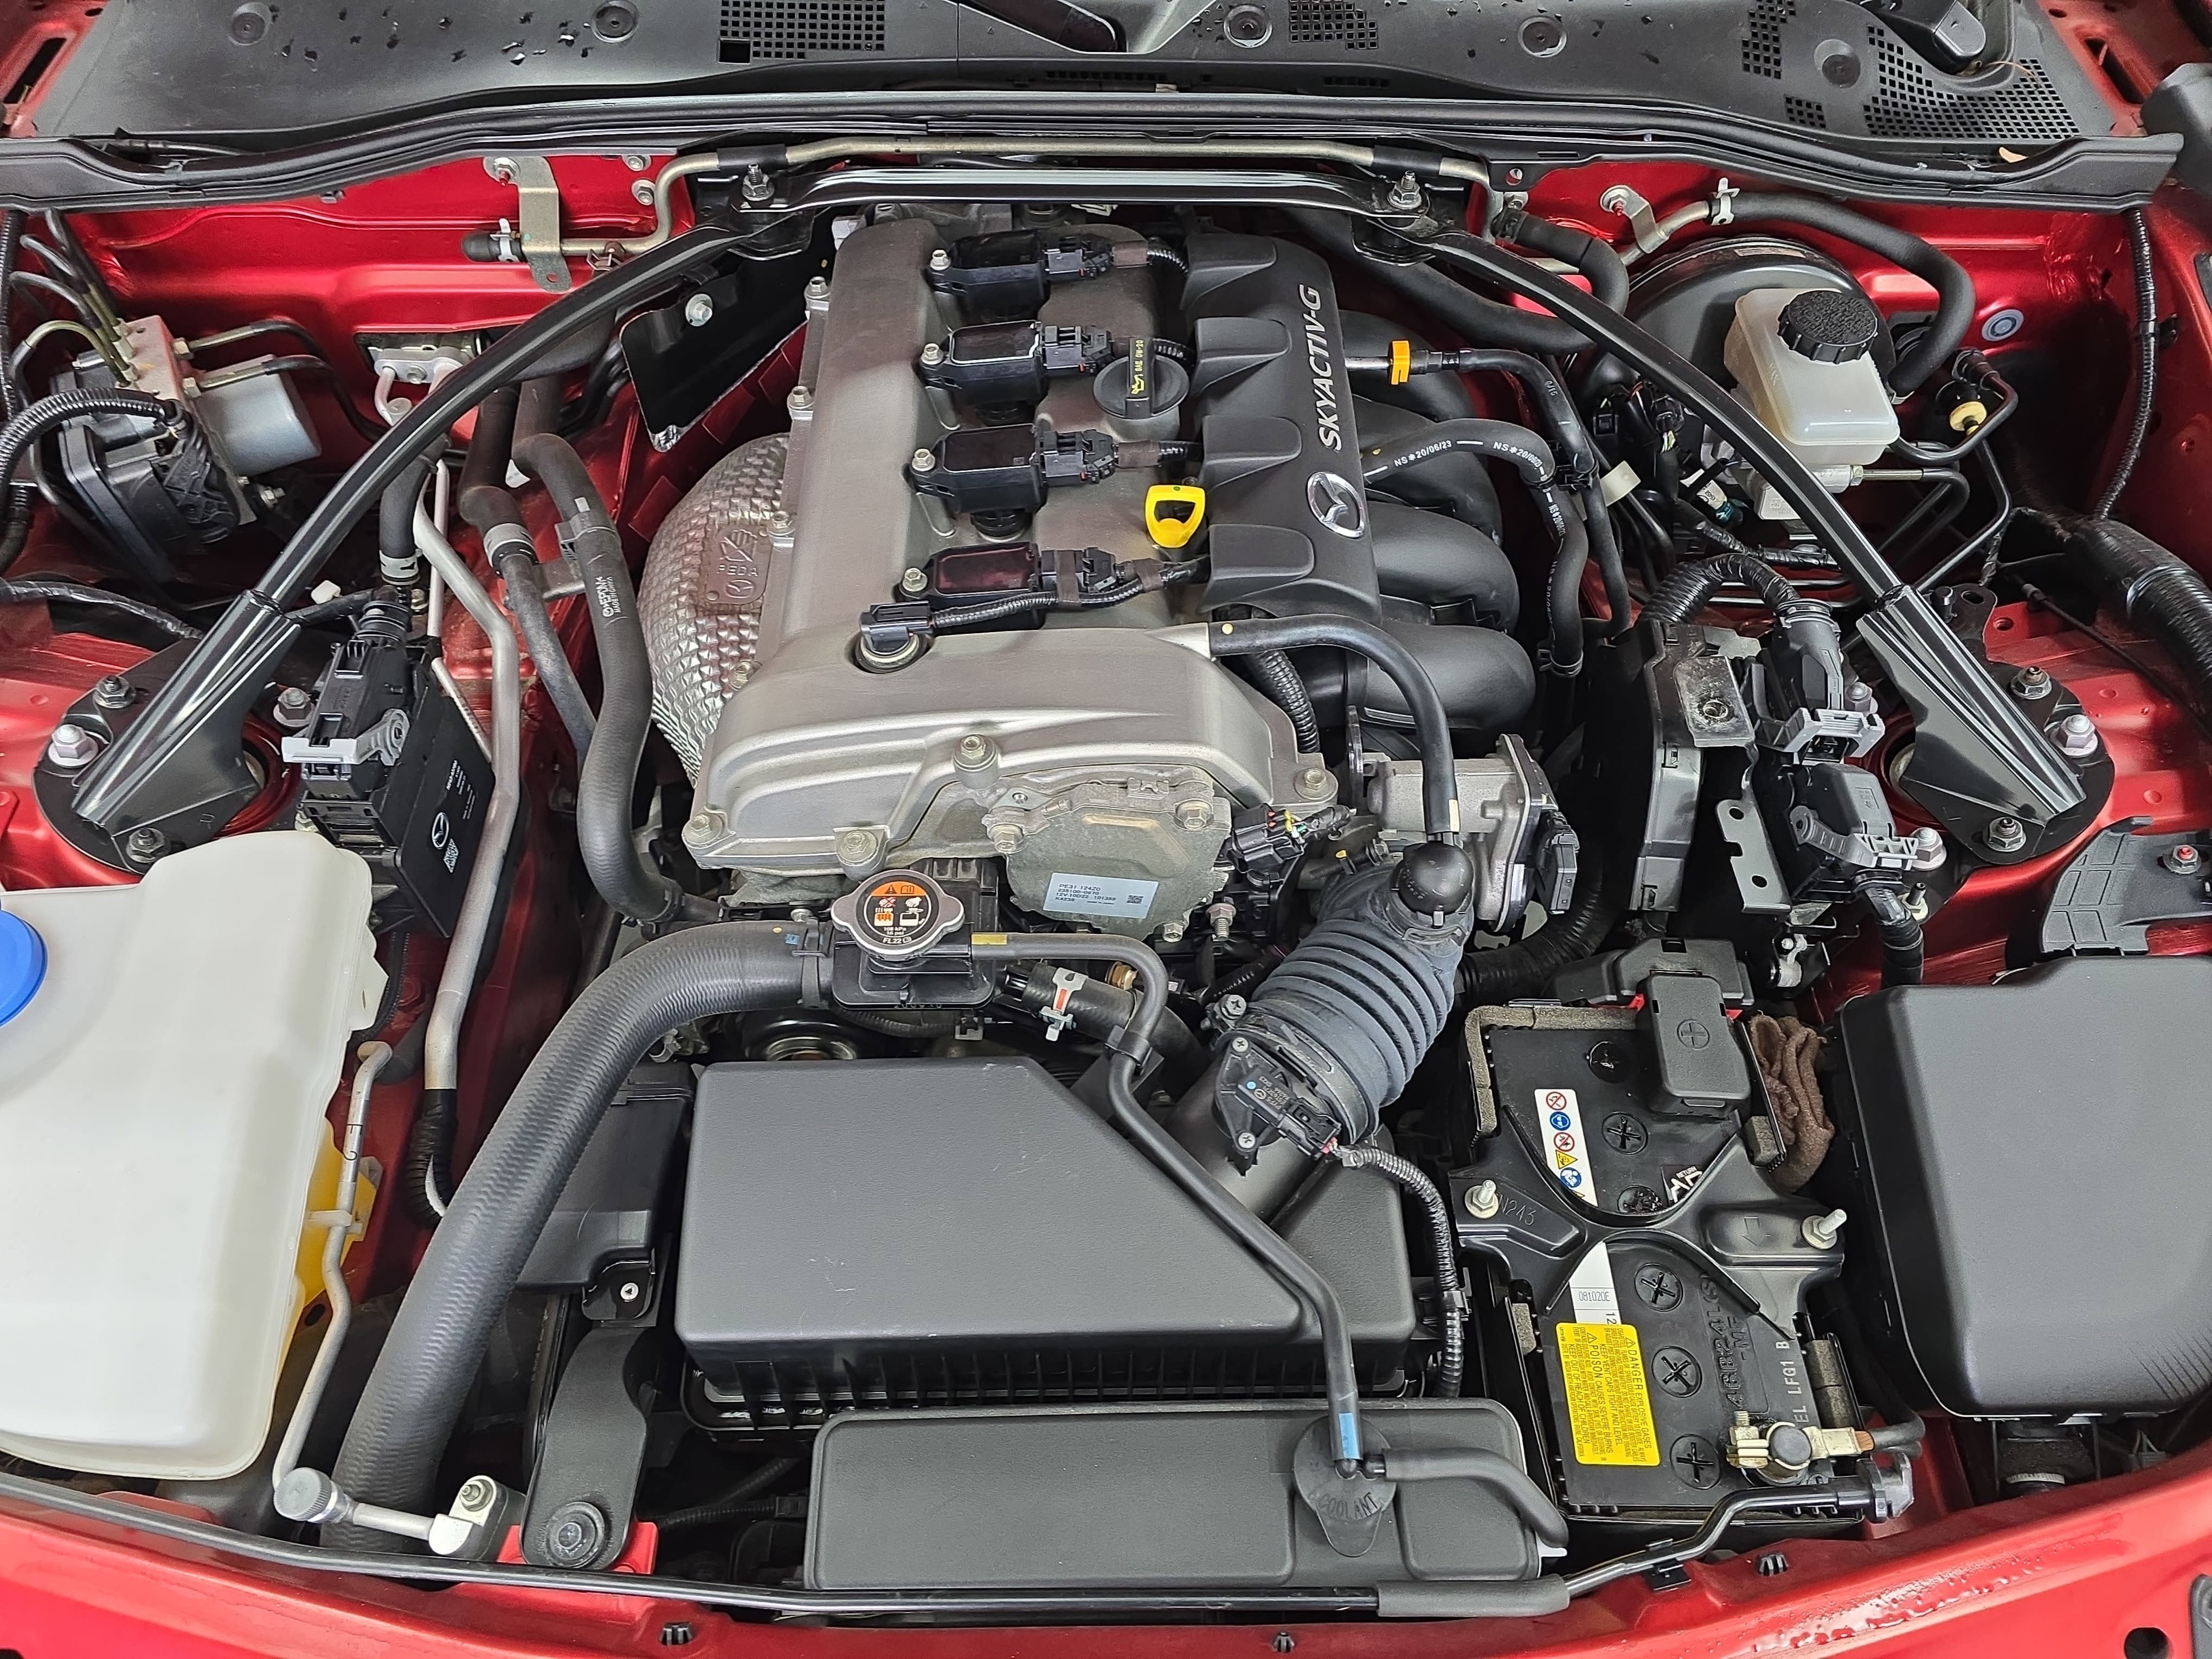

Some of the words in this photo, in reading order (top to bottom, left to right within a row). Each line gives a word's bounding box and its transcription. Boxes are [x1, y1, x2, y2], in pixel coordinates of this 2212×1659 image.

[1300, 284, 1342, 452] SKYACTIV-G
[1675, 1166, 1697, 1179] RETURN
[1567, 1344, 1577, 1358] KEEP
[1599, 1343, 1608, 1358] KEEP
[1775, 1341, 1790, 1349] B
[1570, 1360, 1579, 1372] OUT
[1589, 1345, 1603, 1378] POISON
[1602, 1360, 1611, 1375] VENT
[1628, 1350, 1643, 1390] DANGER
[1574, 1382, 1584, 1402] REACH
[1594, 1380, 1605, 1404] CAUSES
[1605, 1377, 1614, 1392] CAPS
[1607, 1394, 1617, 1411] TIGHT
[1635, 1393, 1648, 1425] EXPLOSIVE
[1599, 1406, 1610, 1430] SEVERE
[1611, 1413, 1619, 1425] AND
[1579, 1414, 1590, 1443] CHILDREN
[1613, 1427, 1623, 1445] LEVEL
[1641, 1427, 1651, 1448] GASES
[1603, 1432, 1613, 1452] BURNS
[1319, 1492, 1382, 1521] COOLANT
